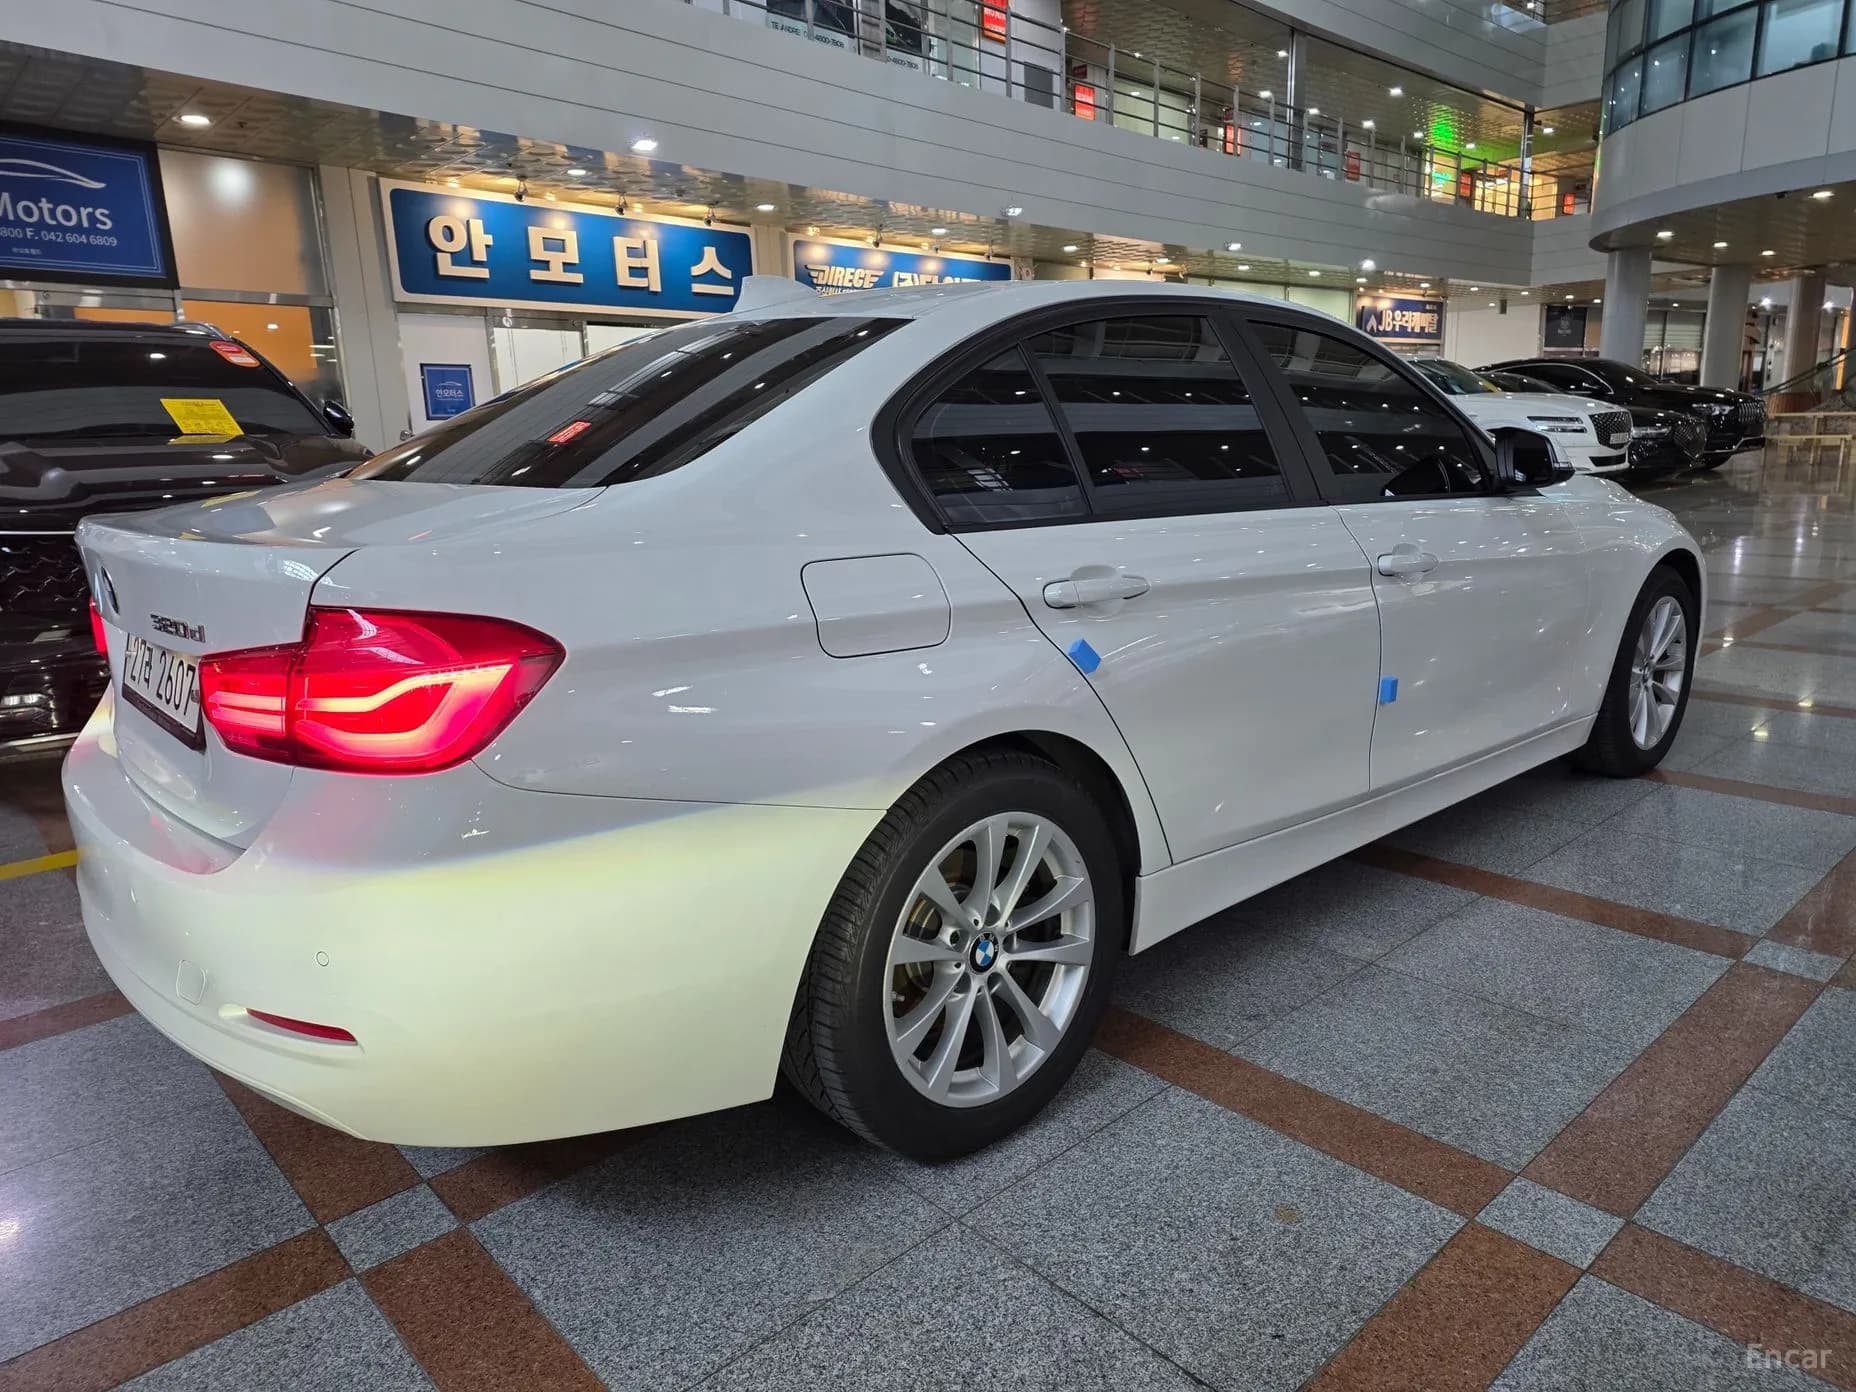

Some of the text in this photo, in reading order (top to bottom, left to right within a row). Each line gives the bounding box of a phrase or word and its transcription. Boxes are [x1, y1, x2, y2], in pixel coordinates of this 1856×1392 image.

[26, 228, 39, 240] F.
[41, 231, 63, 242] 042
[65, 233, 88, 244] 604
[89, 235, 118, 246] 6809
[156, 650, 196, 715] 2607
